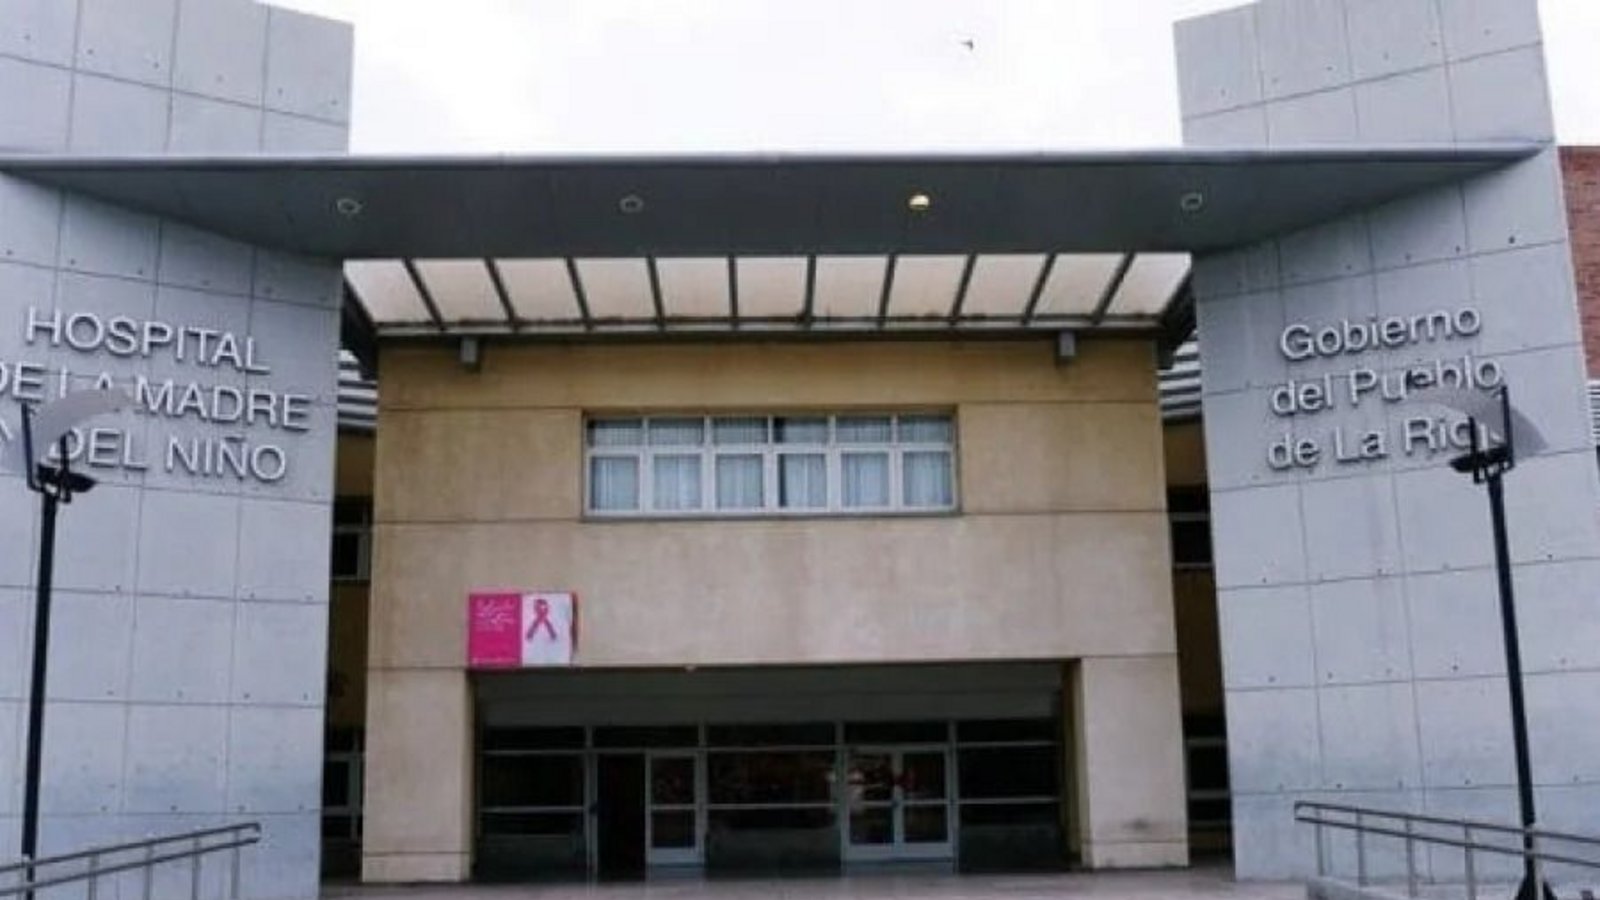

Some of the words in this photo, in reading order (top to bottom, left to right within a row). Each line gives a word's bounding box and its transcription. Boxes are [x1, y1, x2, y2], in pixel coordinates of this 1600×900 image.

[25, 304, 270, 374] HOSPITAL
[1280, 306, 1481, 361] Gobierno
[134, 374, 312, 432] MADRE
[1271, 372, 1333, 415] del
[1350, 354, 1502, 407] Pueblo
[165, 434, 287, 483] NIÑO
[1267, 431, 1321, 470] de
[1335, 425, 1387, 463] La
